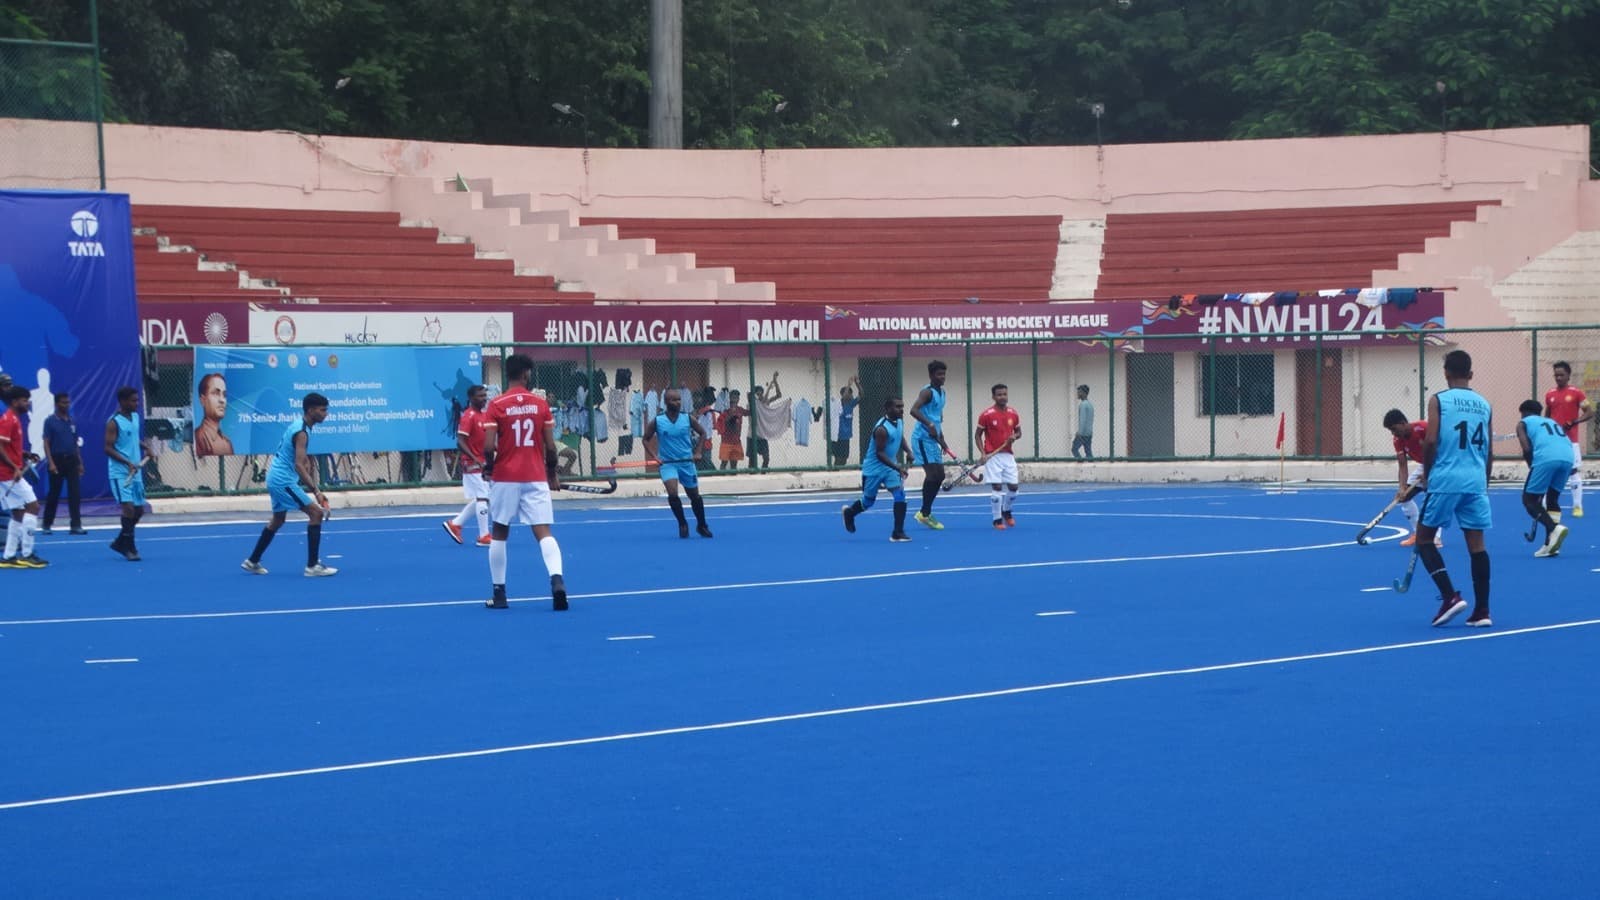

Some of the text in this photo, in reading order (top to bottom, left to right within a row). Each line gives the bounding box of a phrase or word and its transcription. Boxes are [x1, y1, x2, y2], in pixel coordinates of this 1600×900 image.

[67, 241, 105, 256] TATA
[859, 314, 1109, 330] NATIONAL WOMEN'S HOCKEY LEAGUE
[1198, 302, 1386, 343] #NWHL24
[139, 319, 189, 345] NDIA
[544, 319, 713, 343] #INDIAKAGAME
[746, 319, 820, 342] RANCHI
[970, 331, 1054, 345] JHARKHAND
[294, 382, 318, 390] National
[319, 383, 337, 391] Sports
[337, 382, 349, 392] Day
[328, 397, 367, 408] oundation
[368, 396, 387, 406] hosts
[238, 413, 251, 423] 7th
[252, 413, 276, 423] Senior
[338, 412, 363, 423] Hockey
[365, 409, 416, 422] Championship
[417, 409, 434, 419] 2024
[339, 424, 351, 433] and
[511, 418, 535, 447] 12
[1454, 420, 1484, 450] 14
